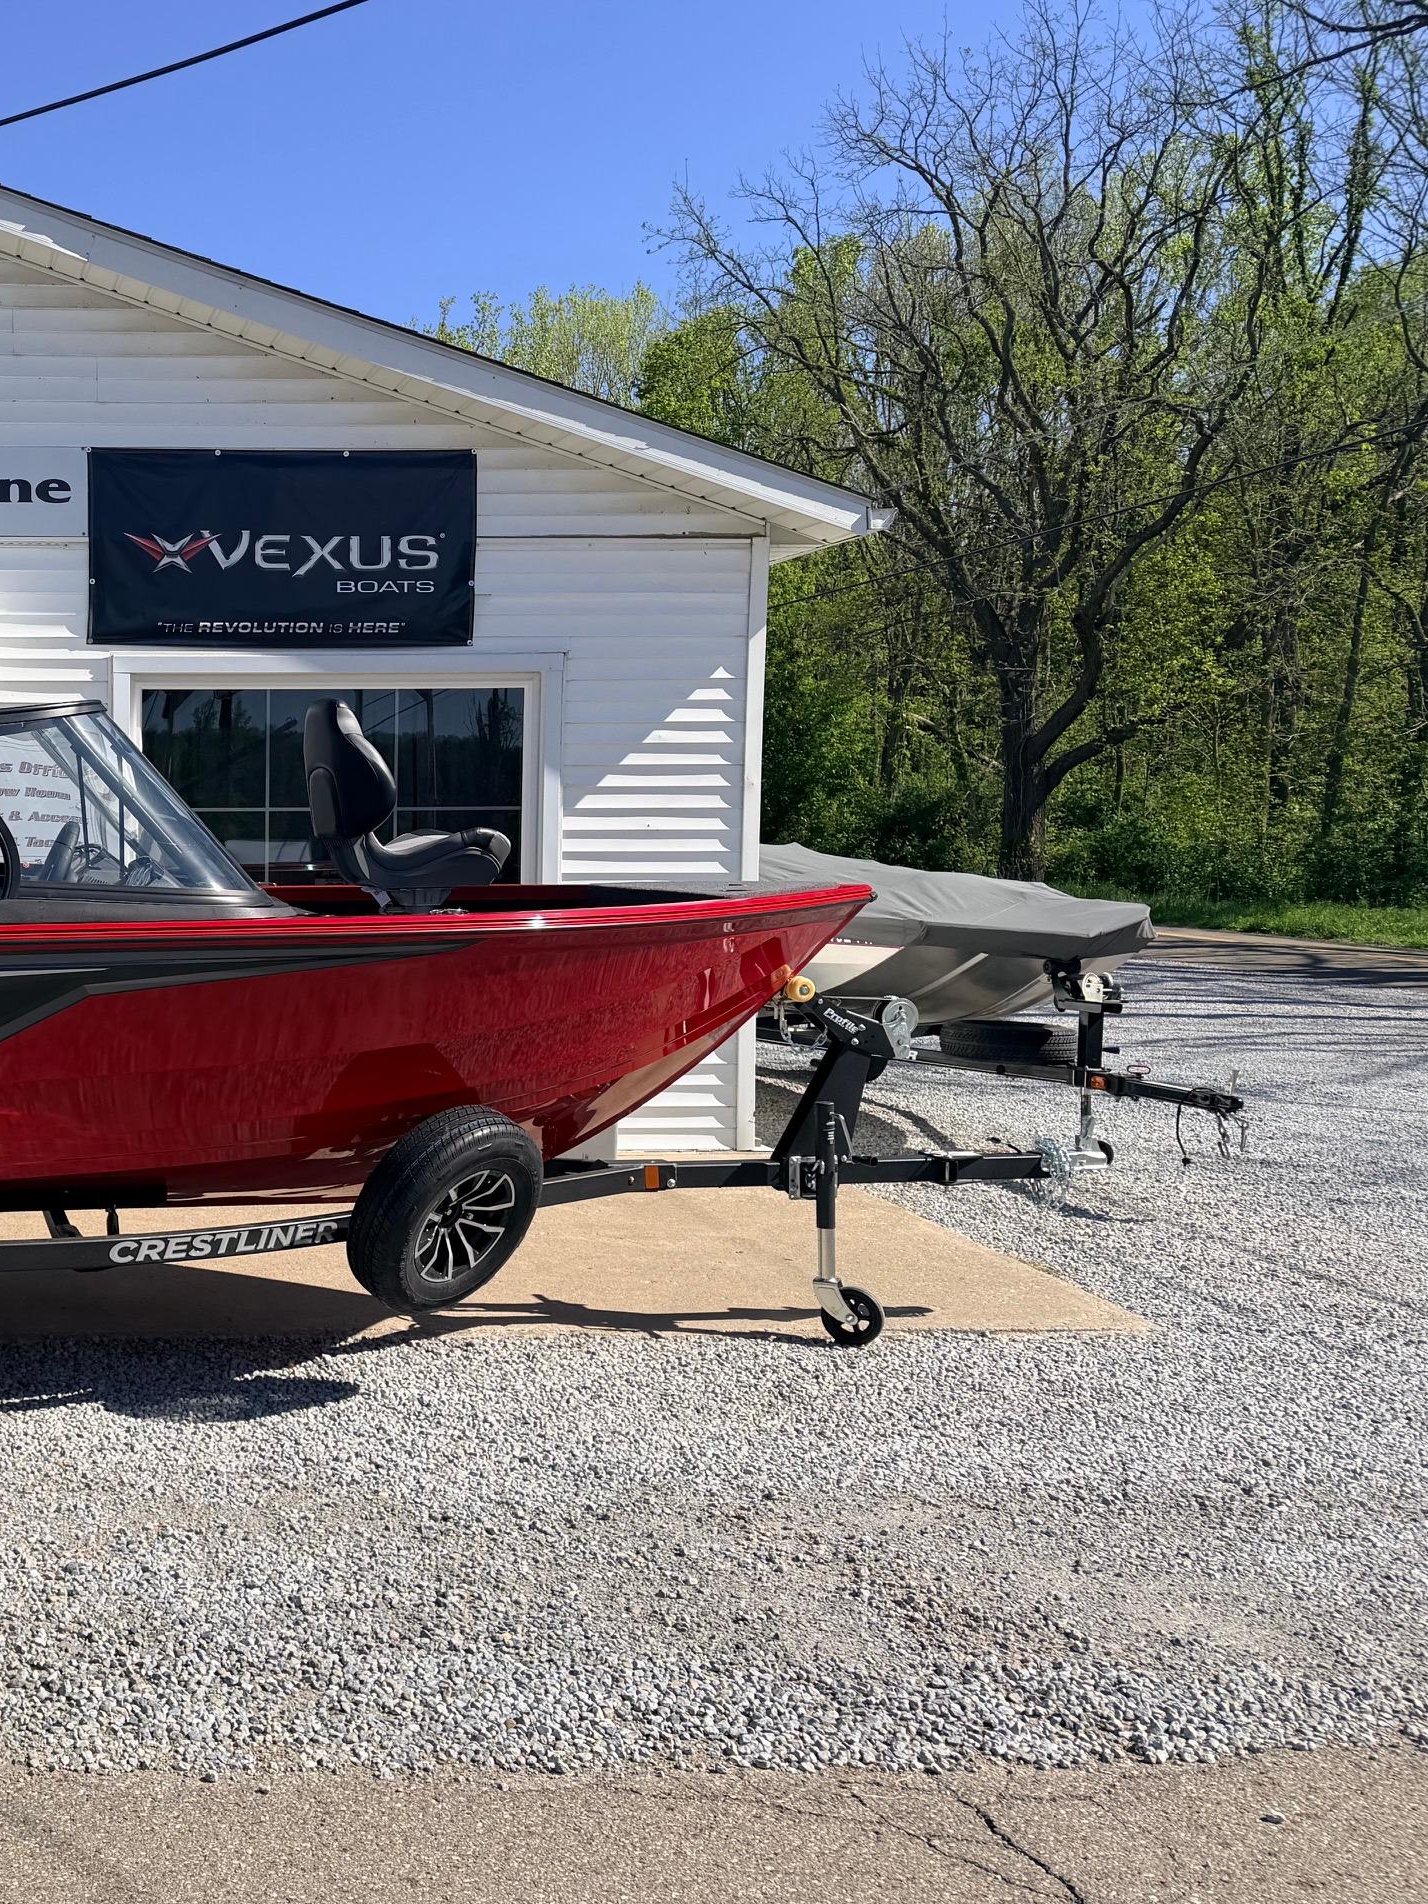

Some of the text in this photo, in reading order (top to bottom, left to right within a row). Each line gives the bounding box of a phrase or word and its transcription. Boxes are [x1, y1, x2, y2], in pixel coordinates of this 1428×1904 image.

[336, 579, 436, 594] BOATS
[198, 621, 324, 634] REVOLUTION
[328, 623, 343, 634] IS
[108, 1221, 338, 1264] CRESTLINER
